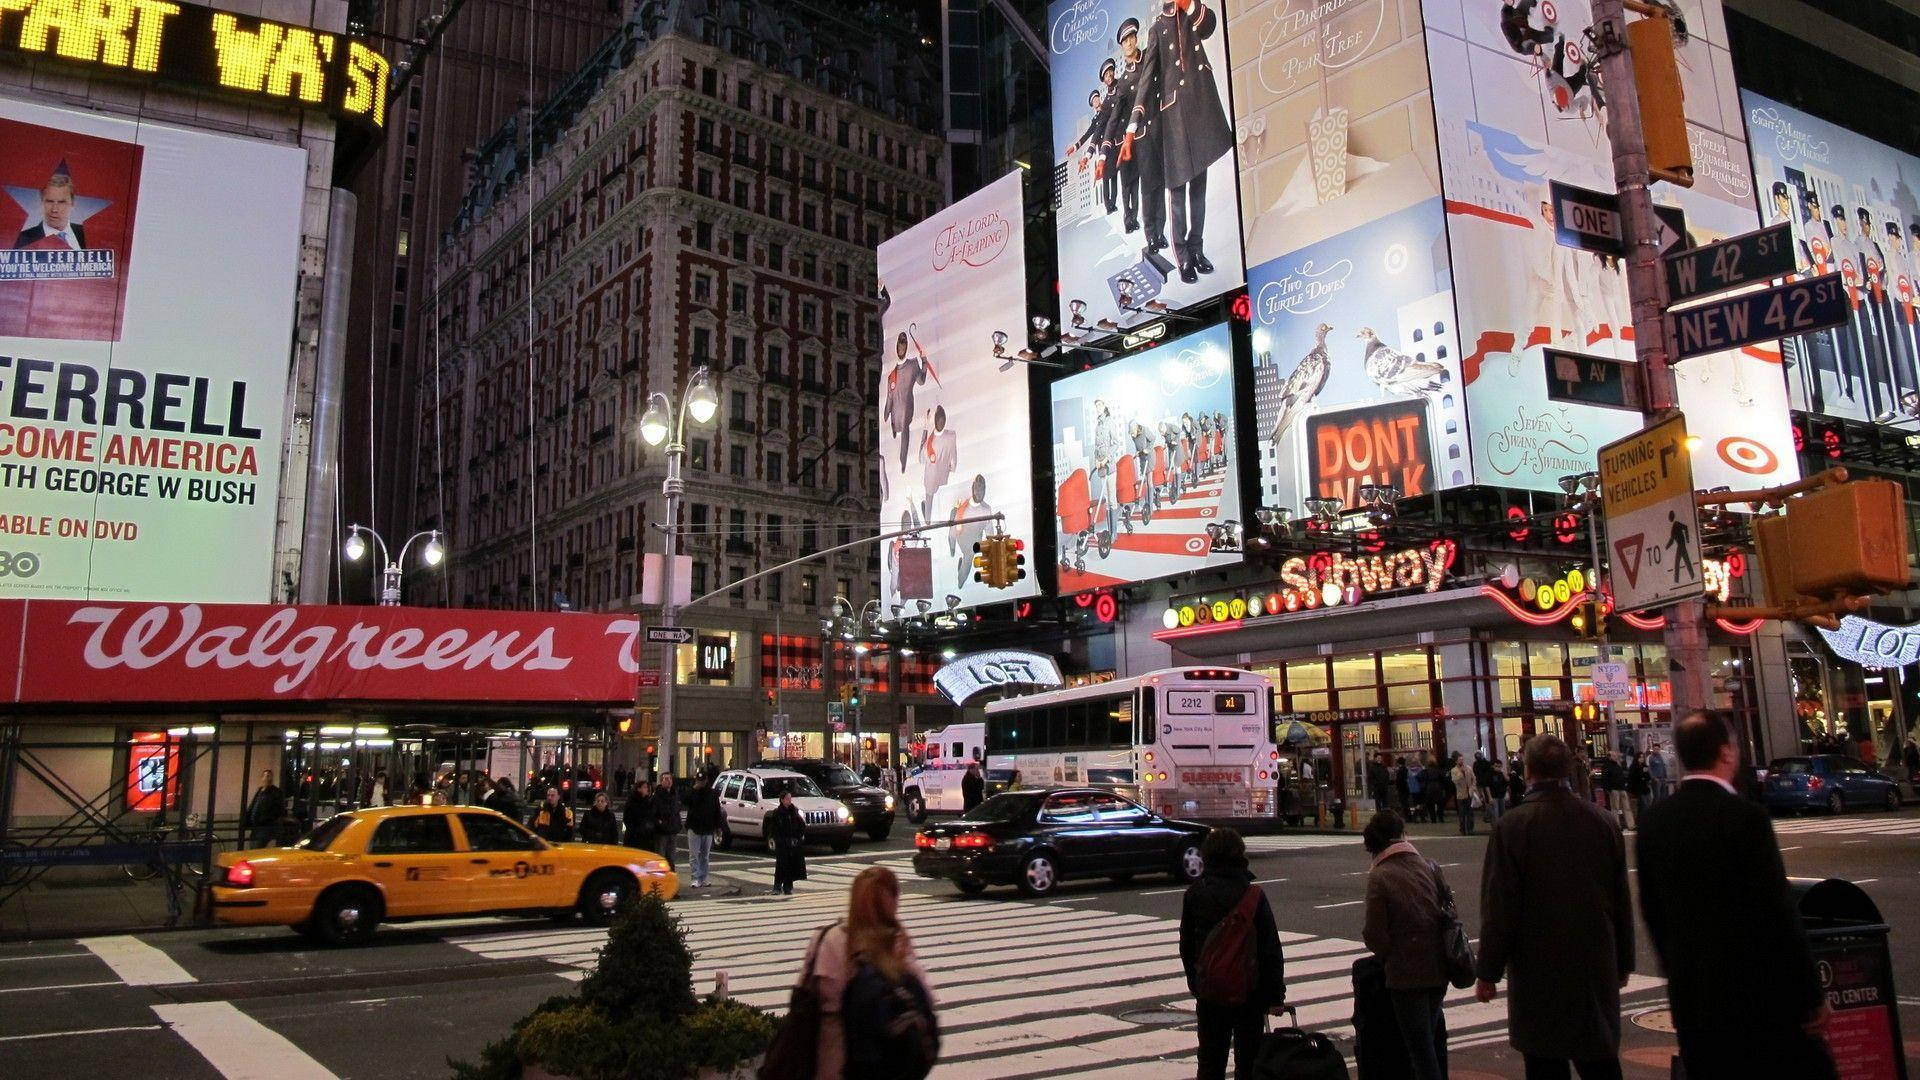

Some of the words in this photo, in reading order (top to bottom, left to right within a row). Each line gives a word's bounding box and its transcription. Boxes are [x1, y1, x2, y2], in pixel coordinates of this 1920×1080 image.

[1572, 206, 1611, 236] ONE
[33, 263, 74, 273] WELCOME
[76, 262, 112, 272] AMERICA
[48, 251, 113, 263] FERRELL
[1676, 258, 1697, 295] W
[1711, 245, 1745, 284] 42
[1758, 232, 1781, 257] ST
[1681, 300, 1750, 351] NEW
[1763, 288, 1815, 329] 42
[1815, 279, 1838, 304] ST
[103, 434, 259, 477] AMERICA
[1604, 440, 1655, 477] TURNING
[44, 466, 150, 498] GEORGE
[157, 475, 182, 499] W
[187, 478, 257, 506] BUSH
[1608, 469, 1657, 504] VEHICLES
[57, 517, 88, 539] ON
[94, 520, 138, 542] DVD
[1645, 545, 1662, 566] TO
[653, 631, 668, 639] ONE
[673, 631, 687, 639] WAY
[68, 603, 574, 694] Walgreens
[704, 645, 727, 670] GAP
[966, 659, 1037, 686] LOFT
[1598, 665, 1620, 674] NYPD
[1181, 697, 1202, 709] 2212
[1842, 986, 1879, 1004] CENTER
